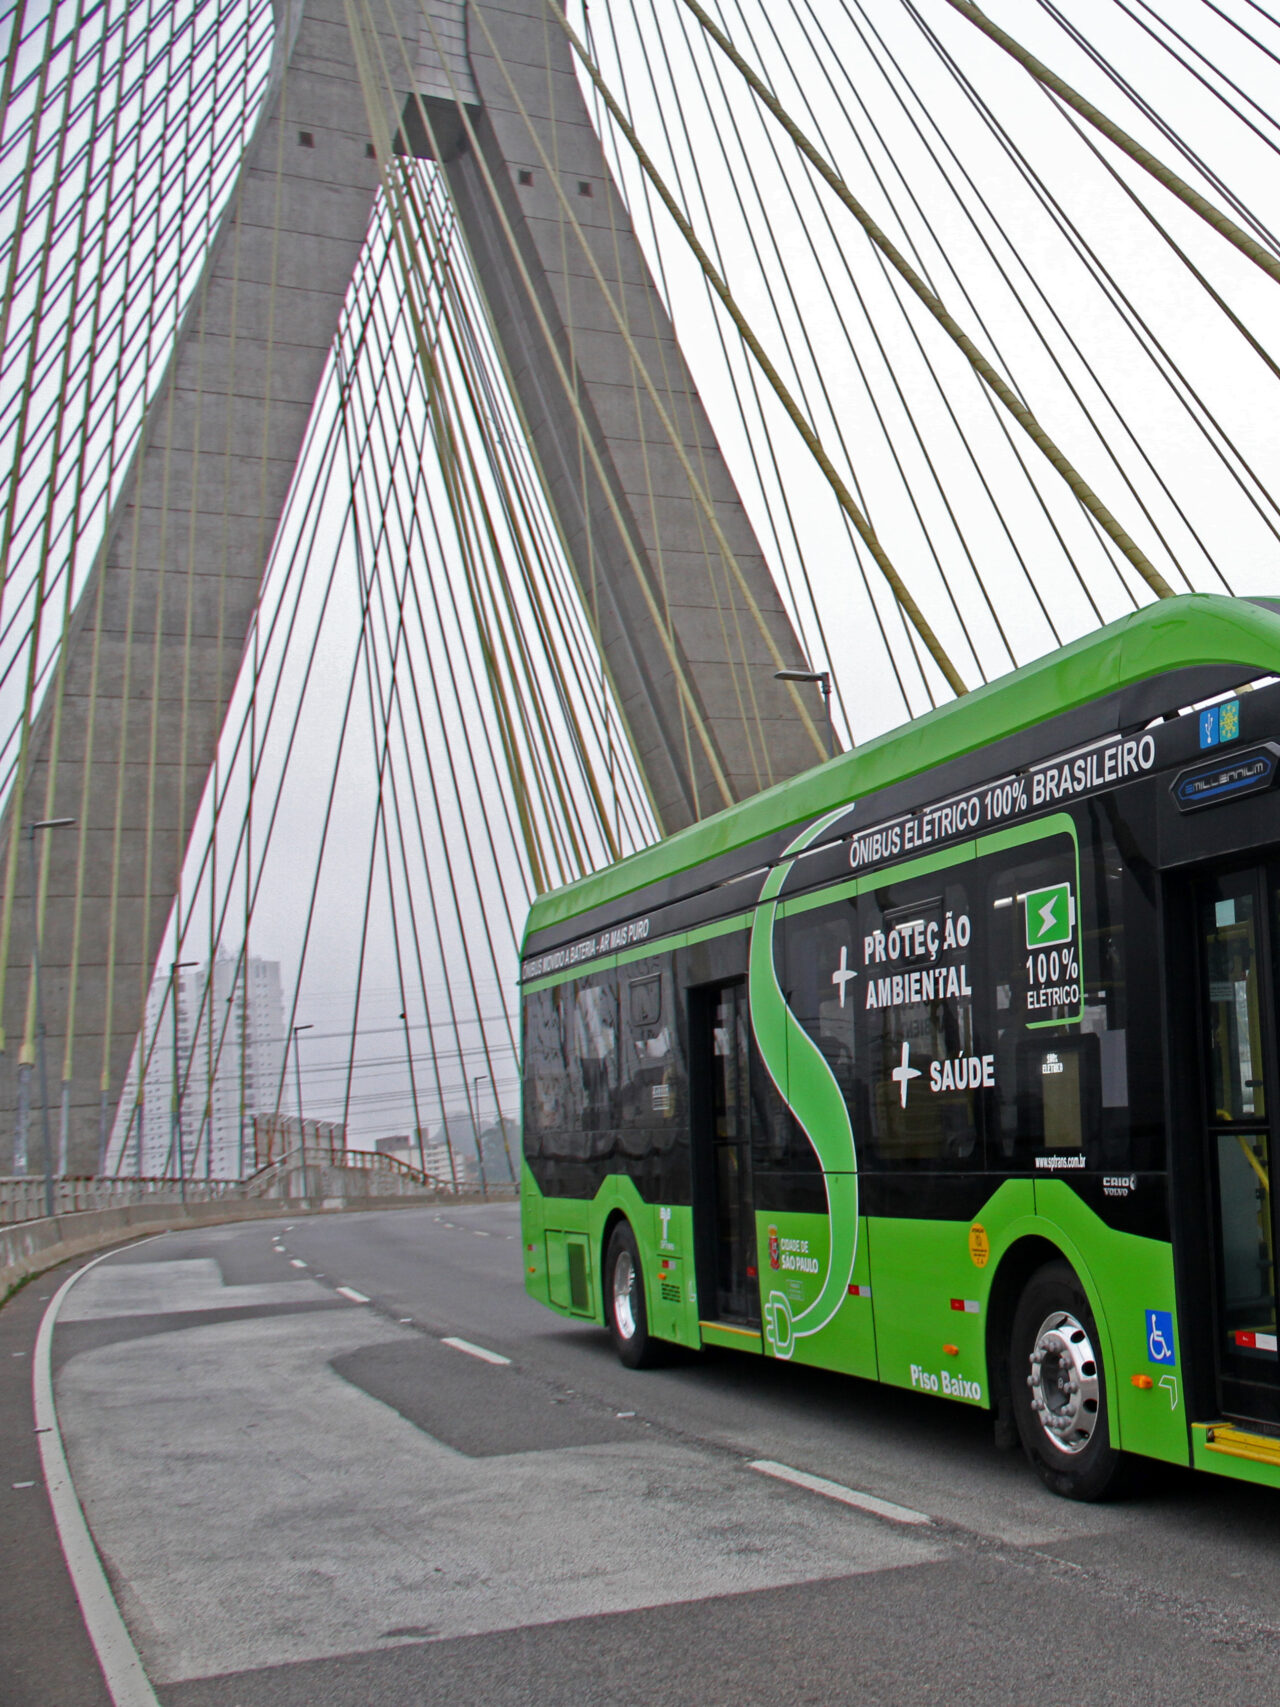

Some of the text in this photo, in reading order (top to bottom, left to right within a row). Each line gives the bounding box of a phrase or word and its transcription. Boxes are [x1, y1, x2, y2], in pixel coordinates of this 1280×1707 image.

[850, 734, 1155, 868] ÔNIBUS ELÉTRICO 100% BRASILEIRO
[542, 952, 564, 972] MOVIDO
[565, 949, 570, 966] A
[570, 938, 596, 964] BATERIA
[599, 934, 610, 952] AR
[610, 927, 627, 948] MAIS
[628, 919, 650, 943] PURO
[864, 911, 971, 965] PROTEÇÃO
[1026, 946, 1078, 984] 100%
[865, 964, 972, 1010] AMBIENTAL
[1027, 984, 1079, 1010] ELÉTRICO
[930, 1050, 995, 1092] SAÚDE
[1035, 1153, 1086, 1172] www.sptrans.com.br
[1103, 1177, 1130, 1186] CAIO
[1103, 1188, 1128, 1196] VOLVO
[782, 1252, 819, 1274] SÃO PAULO
[801, 1240, 808, 1254] DE
[910, 1364, 981, 1400] Piso Baixo
